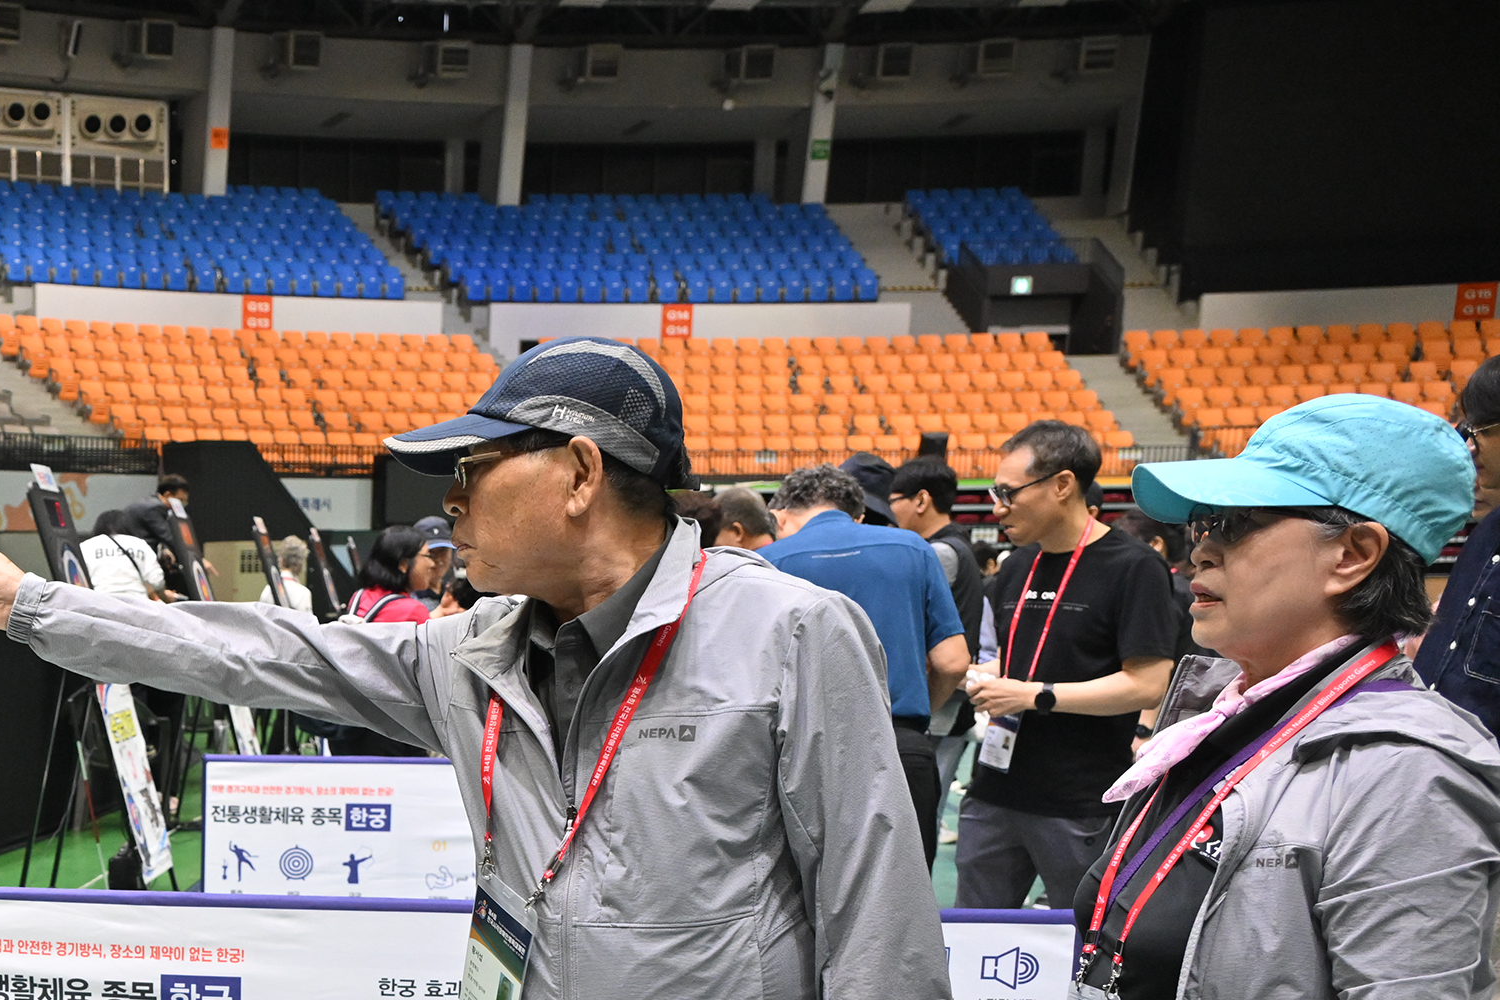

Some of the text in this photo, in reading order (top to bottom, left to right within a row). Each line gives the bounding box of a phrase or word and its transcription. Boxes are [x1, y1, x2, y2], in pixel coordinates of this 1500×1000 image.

[626, 686, 642, 706] 제4회
[1268, 658, 1377, 749] The 4th National Blind Sports Games
[639, 727, 675, 739] NEPA
[211, 804, 387, 829] 전통생활체육 종목 한궁
[432, 841, 447, 851] 01
[1255, 858, 1283, 868] NEP
[18, 940, 53, 956] 안전한
[56, 942, 106, 959] 경기방식,
[110, 944, 145, 960] 장소의
[149, 945, 184, 962] 제약이
[189, 947, 213, 962] 없는
[216, 948, 245, 963] 한궁!
[378, 978, 462, 998] 한궁 효과
